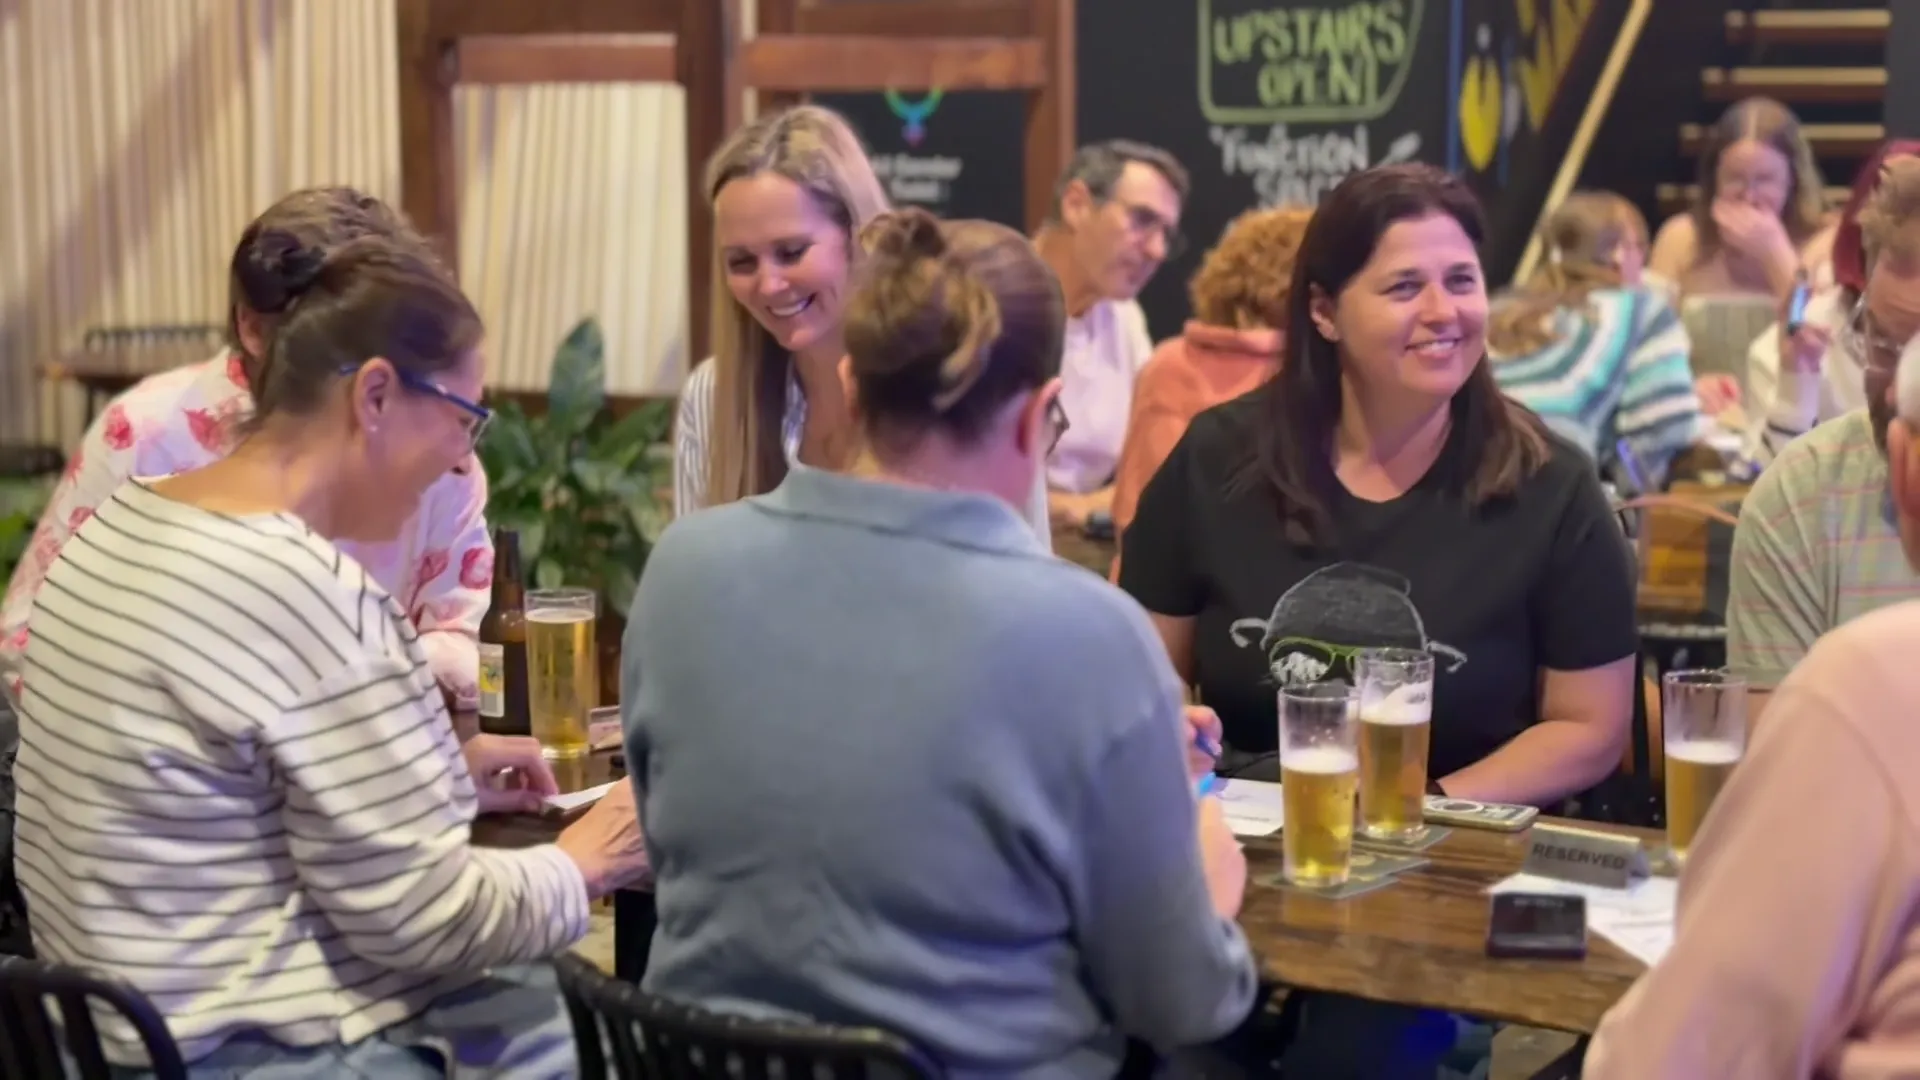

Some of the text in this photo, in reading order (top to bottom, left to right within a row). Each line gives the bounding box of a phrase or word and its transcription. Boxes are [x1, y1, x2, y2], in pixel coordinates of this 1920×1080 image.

[1213, 2, 1405, 64] UPSTAIRS
[1257, 57, 1370, 106] OPEN
[1532, 842, 1627, 870] RESERVED
